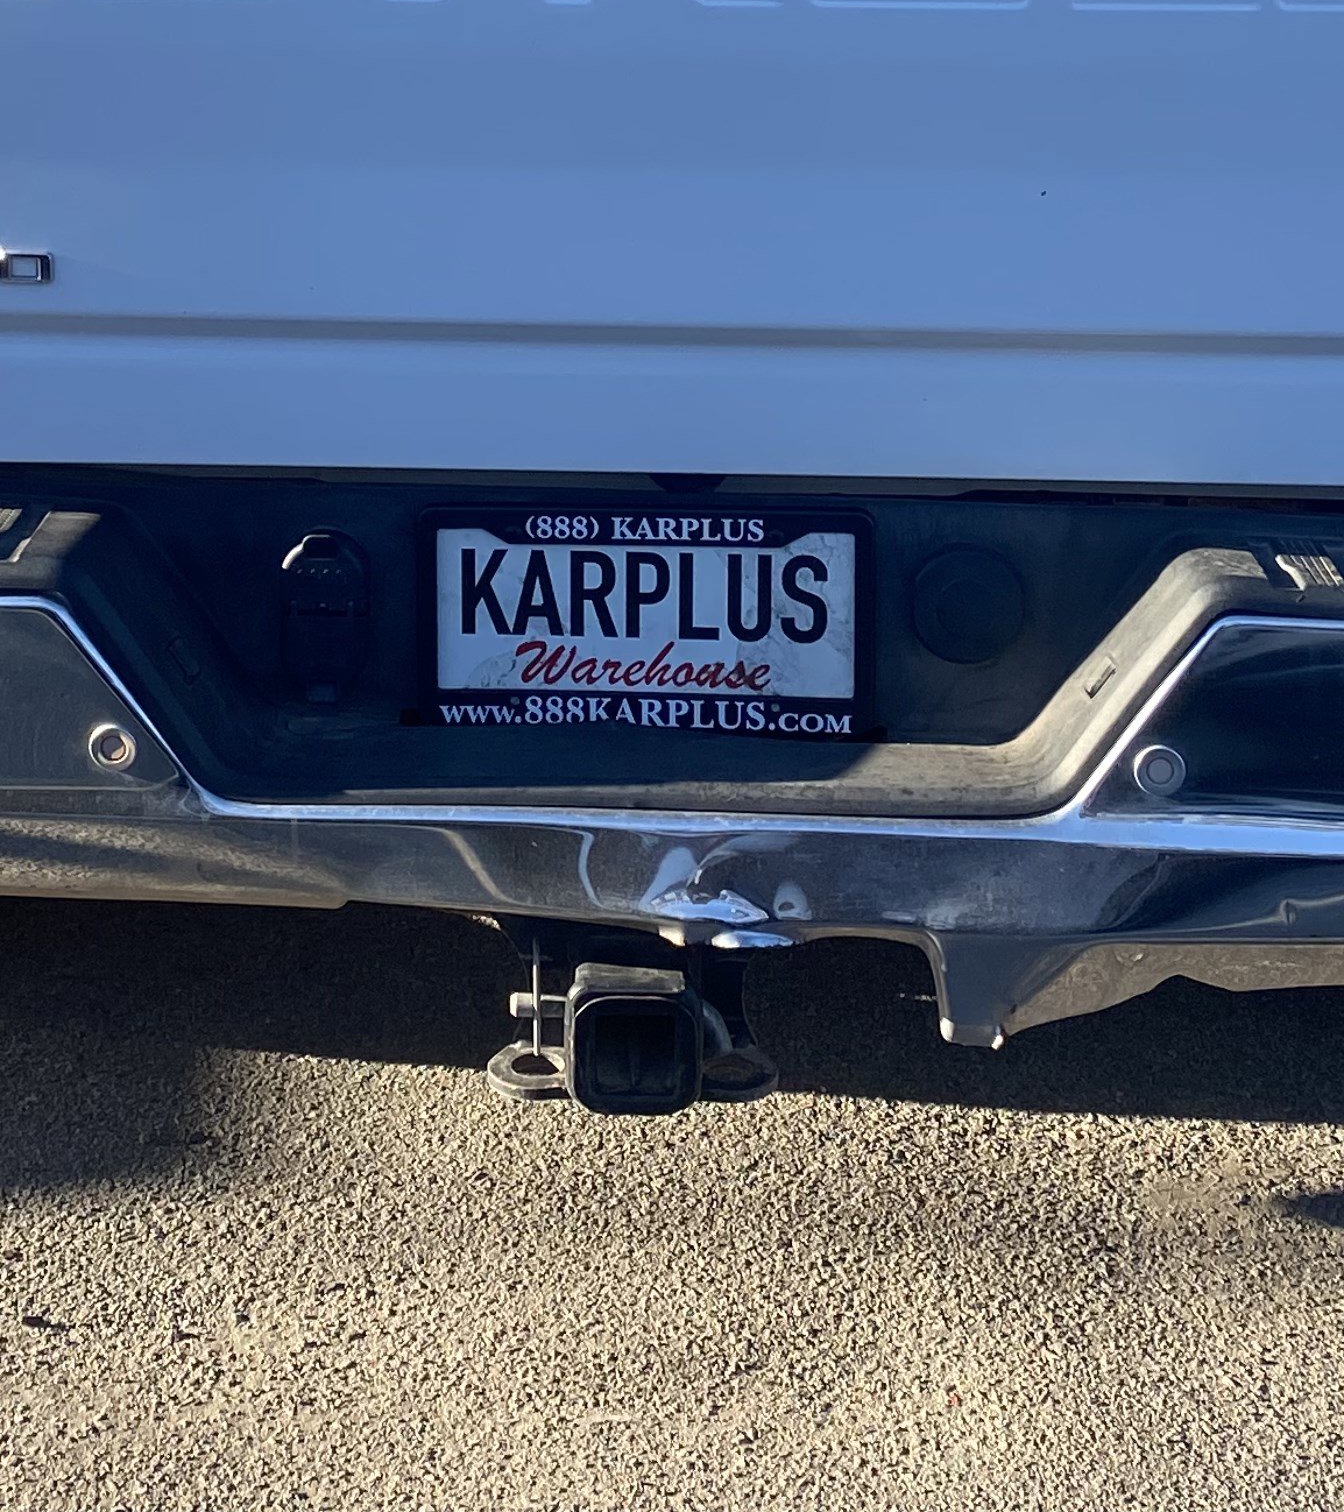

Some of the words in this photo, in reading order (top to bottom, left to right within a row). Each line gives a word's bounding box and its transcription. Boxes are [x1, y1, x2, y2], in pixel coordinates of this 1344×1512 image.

[525, 515, 599, 541] (888)
[611, 516, 765, 542] KARPLUS
[460, 548, 829, 645] KARPLUS
[514, 639, 771, 691] Warehouse
